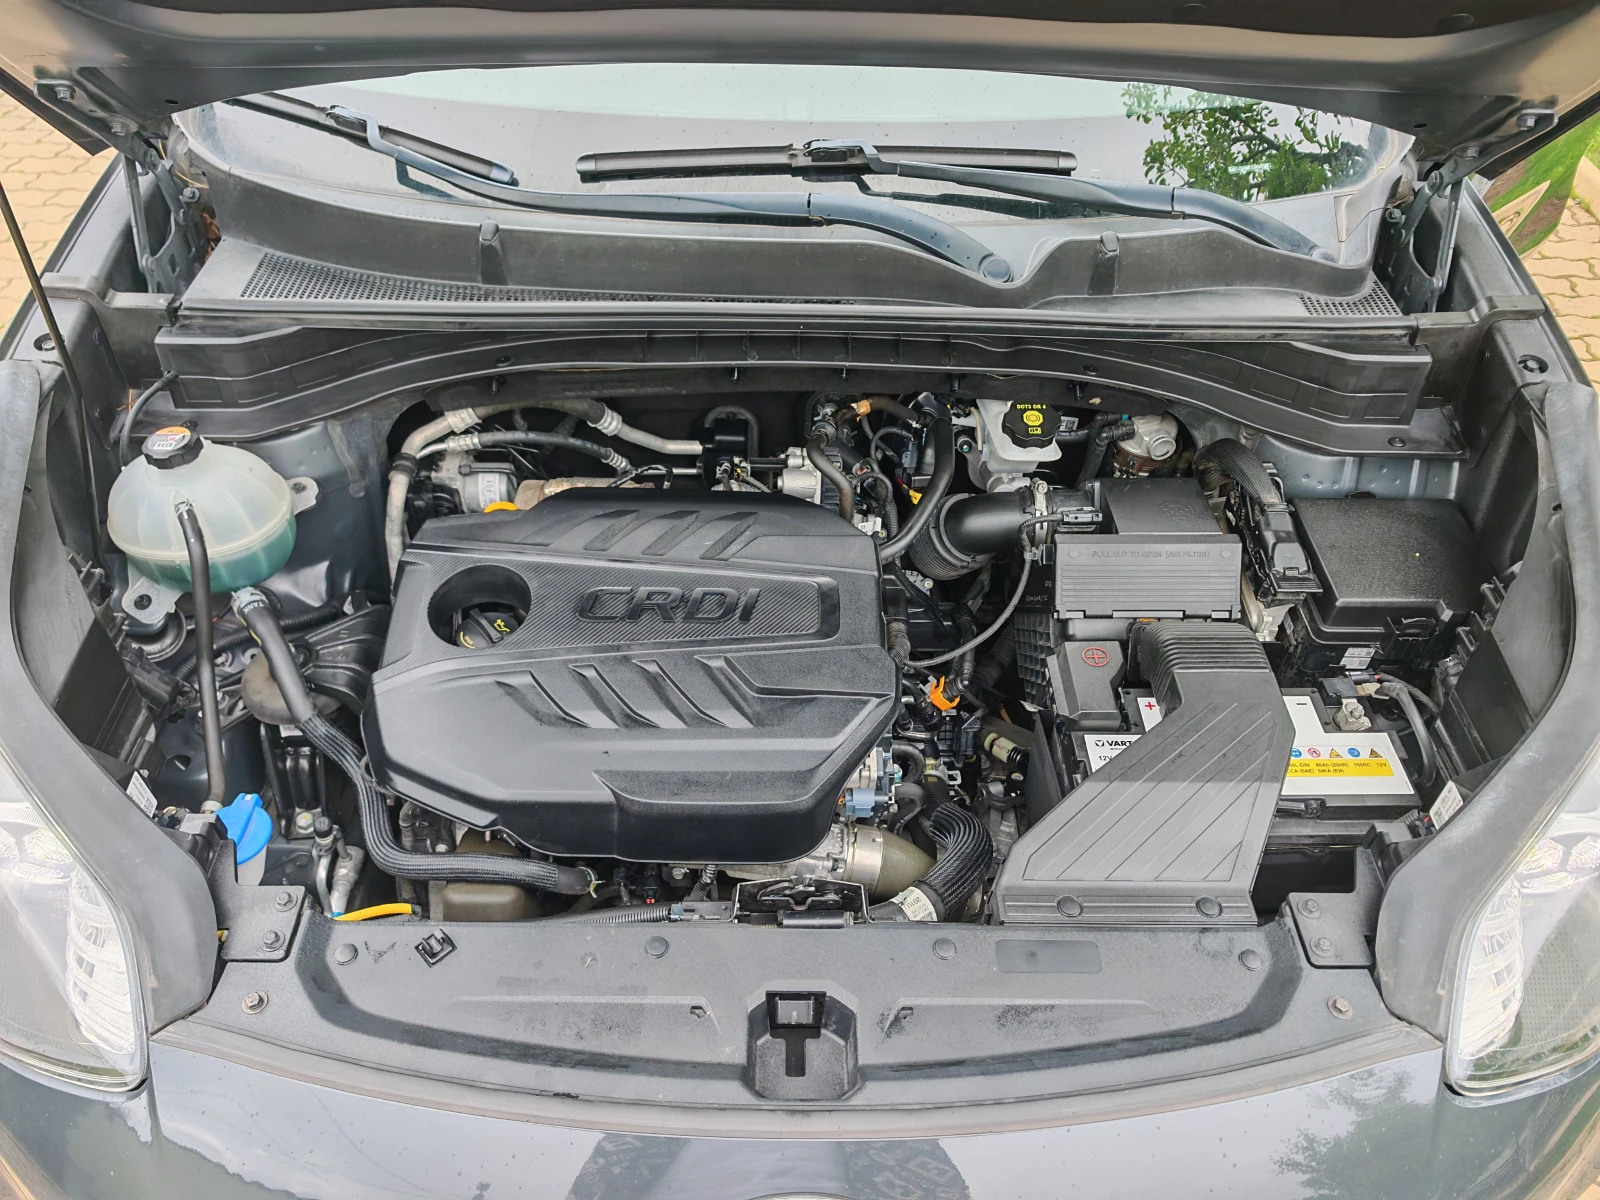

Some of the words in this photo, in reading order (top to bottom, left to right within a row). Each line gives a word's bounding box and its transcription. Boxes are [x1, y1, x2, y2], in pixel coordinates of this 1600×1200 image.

[1091, 550, 1111, 558] PULL
[1112, 550, 1128, 558] OUT
[1130, 550, 1140, 558] TO
[1141, 550, 1162, 558] OPEN
[242, 601, 265, 614] TANK
[577, 586, 761, 623] CRDI
